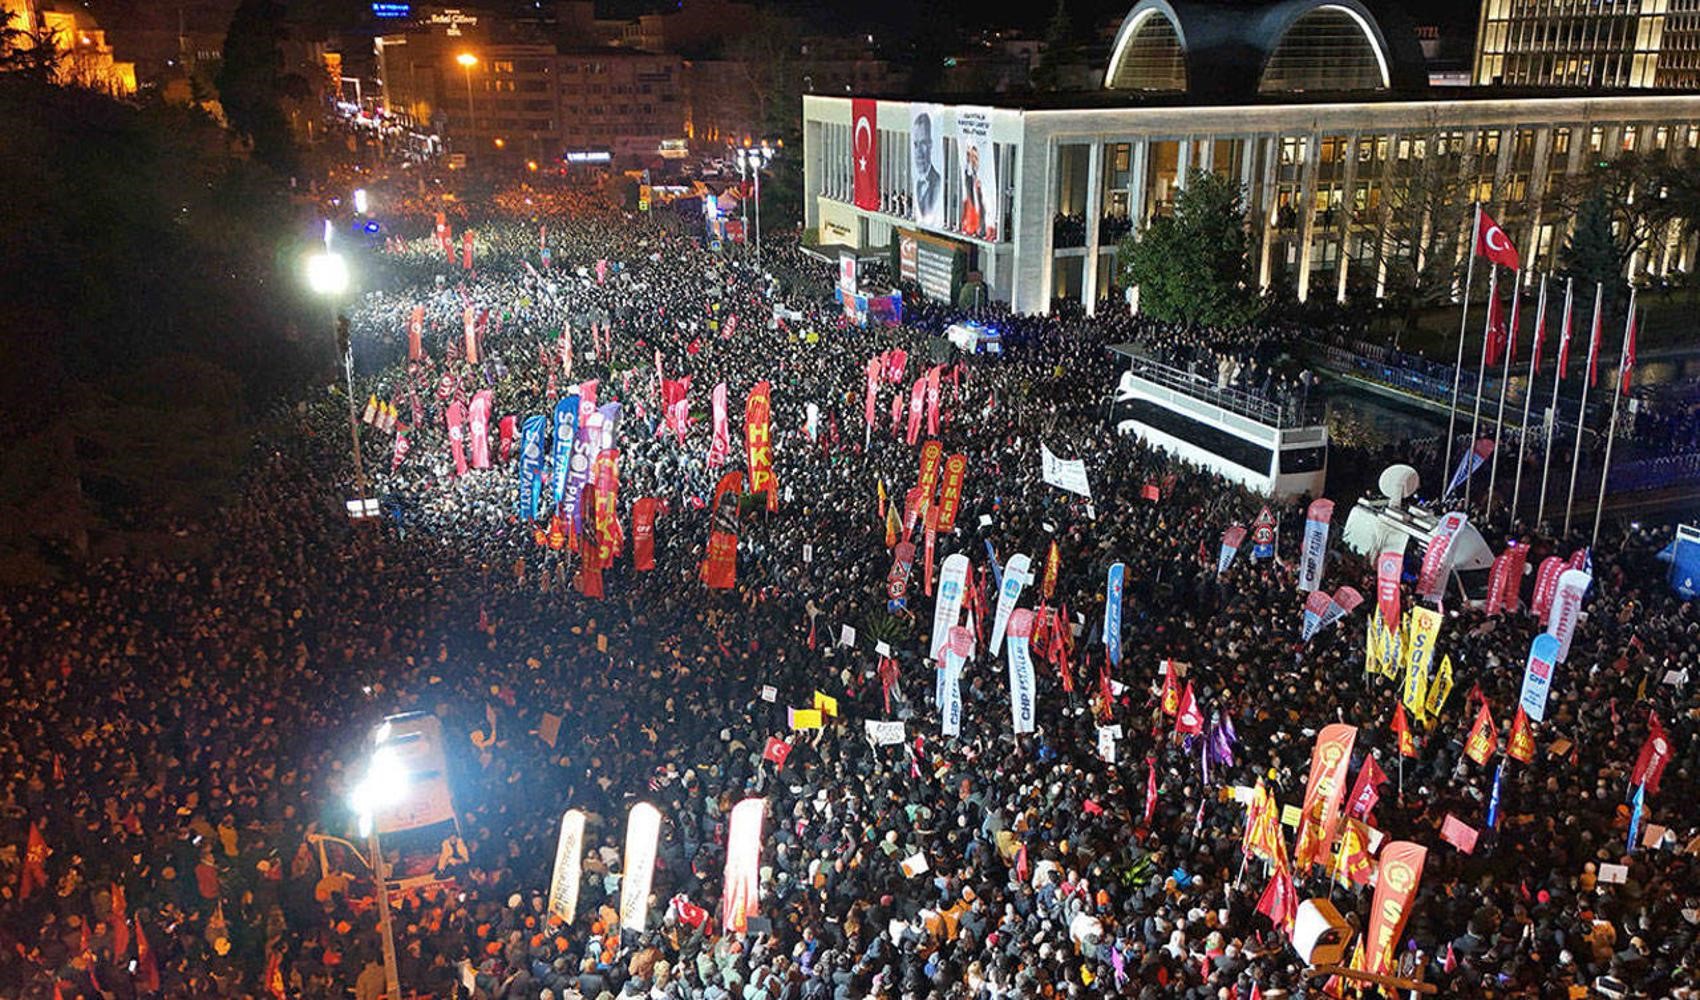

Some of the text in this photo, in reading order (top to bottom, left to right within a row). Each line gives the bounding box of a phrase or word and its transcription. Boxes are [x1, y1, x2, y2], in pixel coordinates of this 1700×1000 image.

[523, 430, 541, 471] SOL
[557, 410, 575, 454] SOL
[565, 438, 588, 484] SOL
[749, 424, 770, 492] HKP
[940, 474, 959, 524] EMEK
[1305, 557, 1317, 582] CHP
[950, 701, 960, 726] CHP
[1020, 692, 1032, 721] CHP
